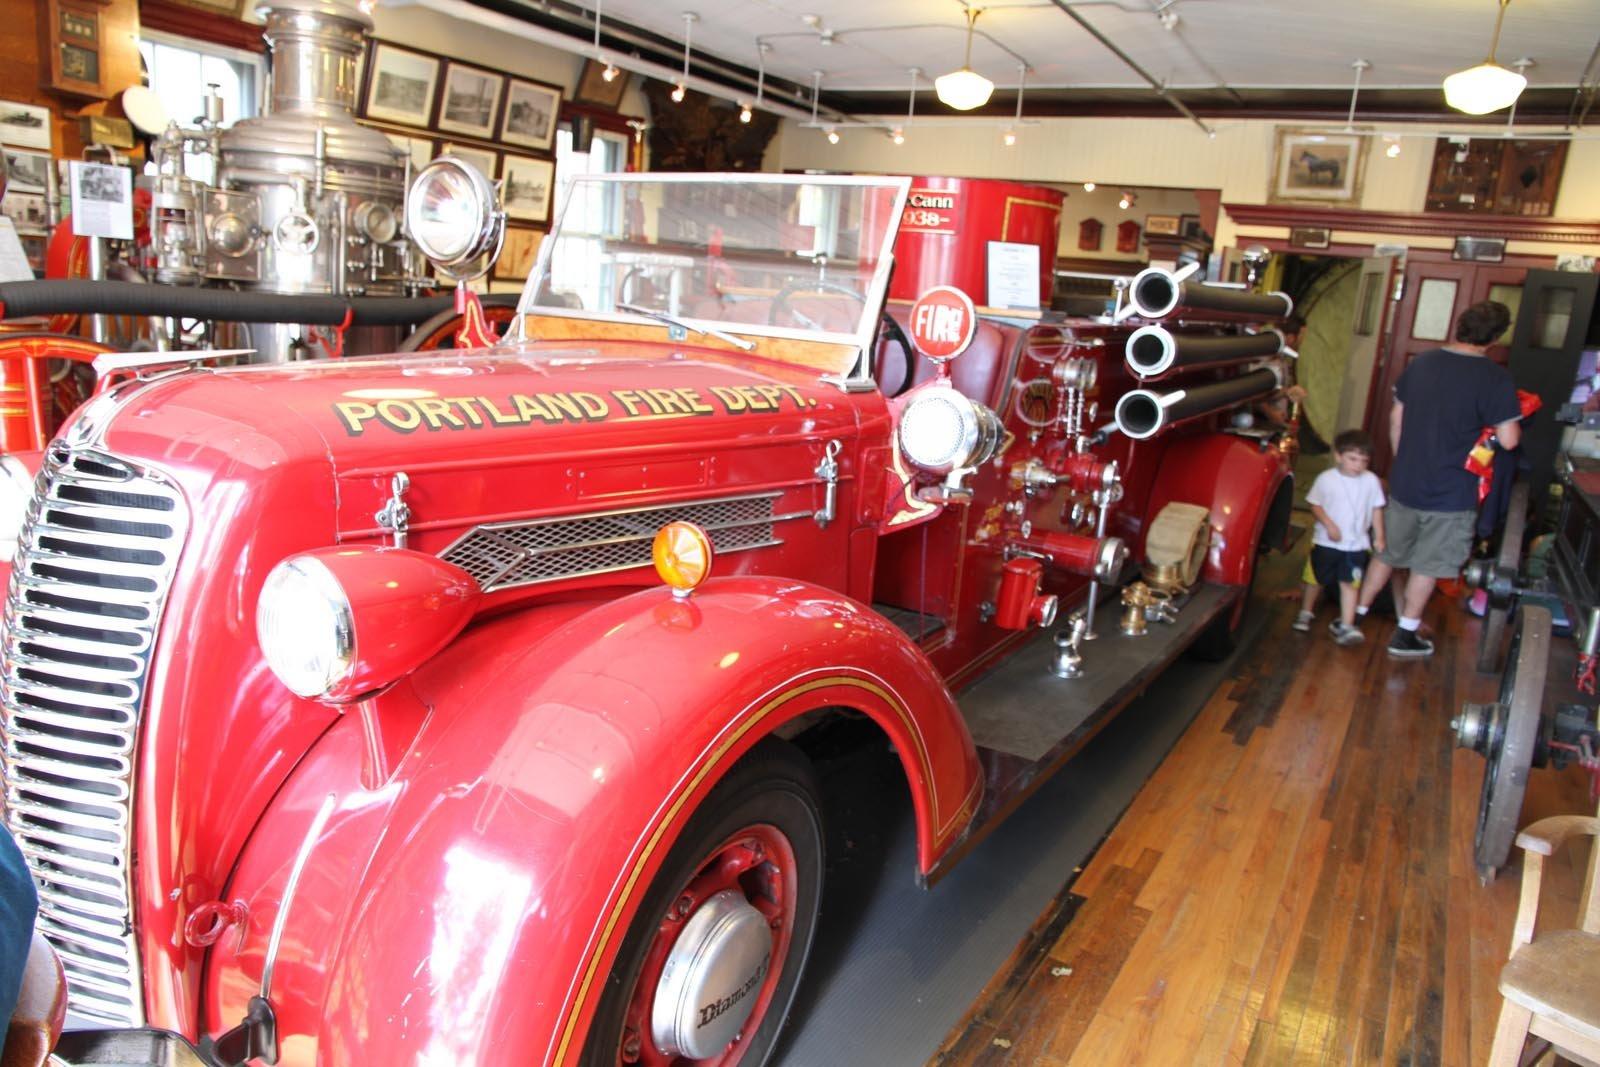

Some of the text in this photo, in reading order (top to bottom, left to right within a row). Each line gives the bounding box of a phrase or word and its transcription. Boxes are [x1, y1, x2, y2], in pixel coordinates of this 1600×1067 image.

[892, 193, 953, 208] Cann
[902, 210, 949, 227] 938-
[915, 304, 963, 342] FIRE
[334, 384, 816, 434] PORTLAND FIRE DEPT.
